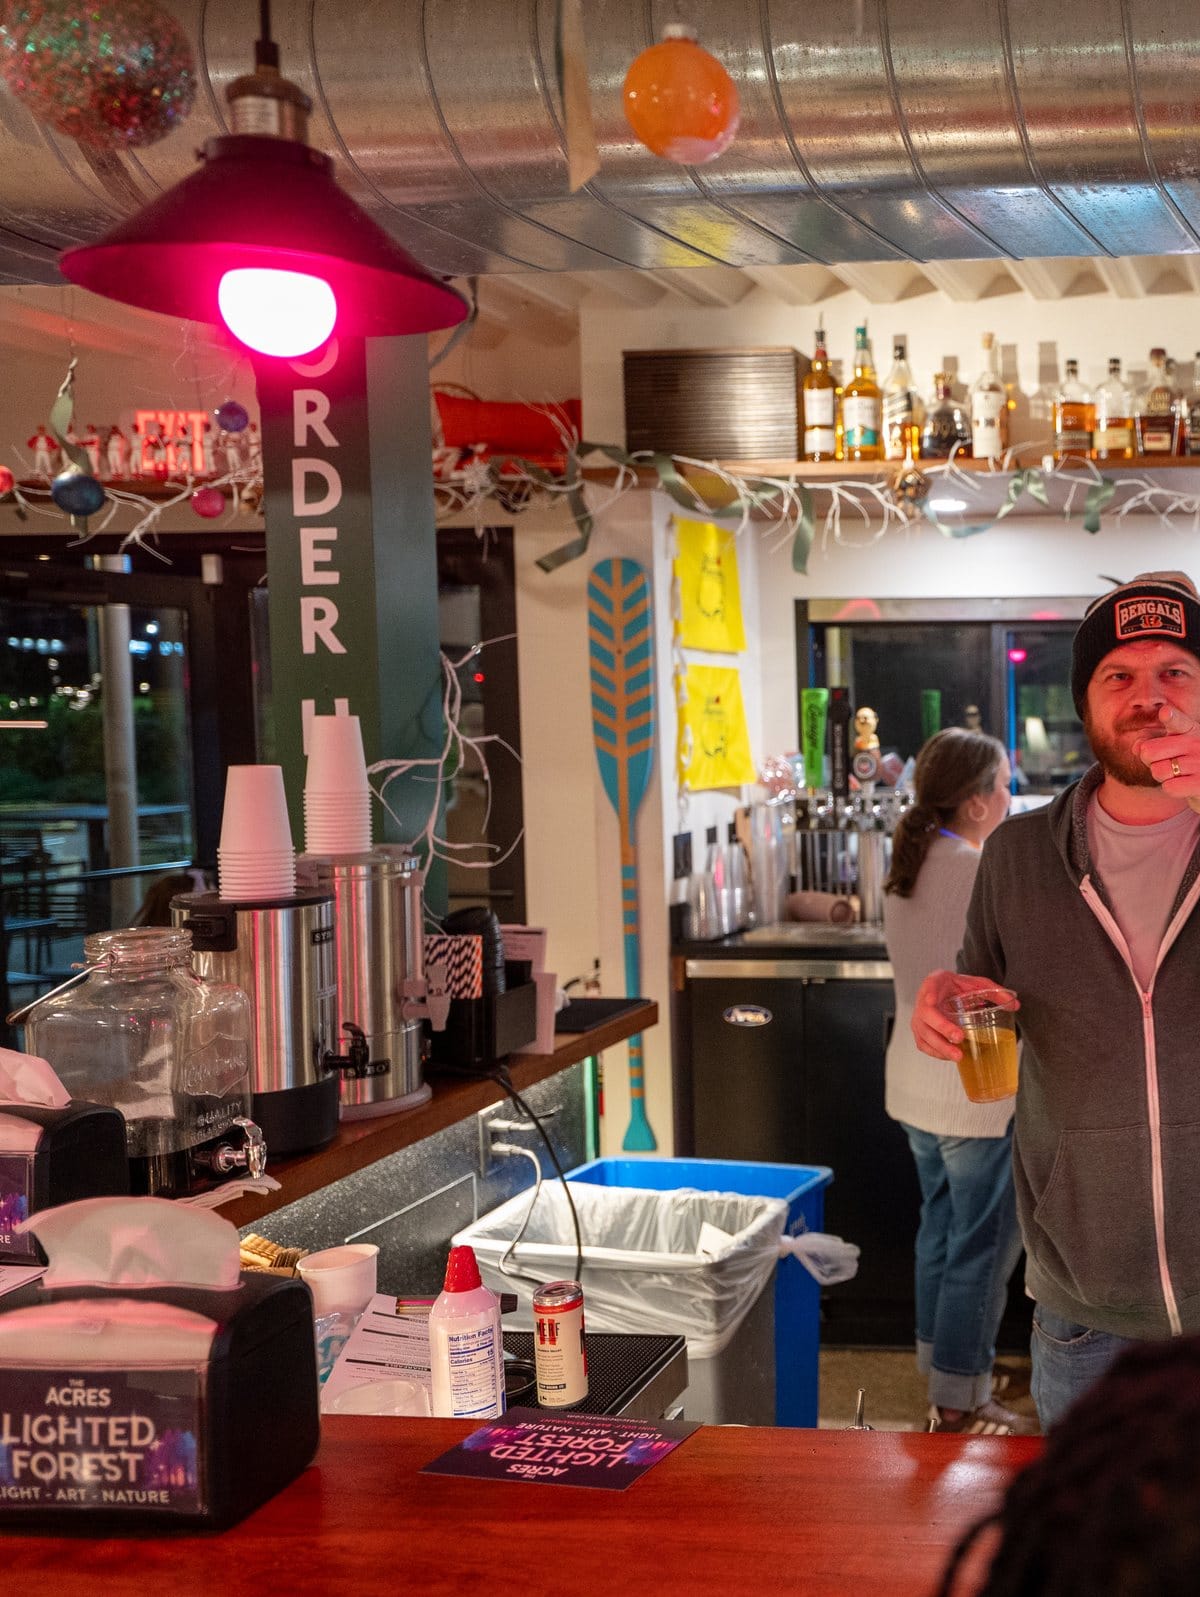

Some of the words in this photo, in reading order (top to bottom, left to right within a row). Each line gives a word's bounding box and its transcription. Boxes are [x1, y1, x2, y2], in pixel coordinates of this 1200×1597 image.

[1120, 602, 1181, 627] BENGALS
[197, 1101, 242, 1127] QUALITY
[449, 1333, 477, 1343] Nutrition
[478, 1327, 494, 1338] Facts
[450, 1357, 473, 1365] Calories
[69, 1379, 85, 1387] THE
[45, 1387, 112, 1407] ACRES
[1, 1412, 156, 1447] LIGHTED
[515, 1422, 571, 1433] NATURE
[584, 1428, 611, 1436] ART
[618, 1431, 663, 1440] LIGHT
[514, 1432, 634, 1452] FOREST
[490, 1445, 627, 1468] LIGHTED
[12, 1449, 145, 1483] FOREST
[506, 1464, 569, 1477] ACRES
[56, 1488, 87, 1502] ART
[102, 1490, 170, 1505] NATURE
